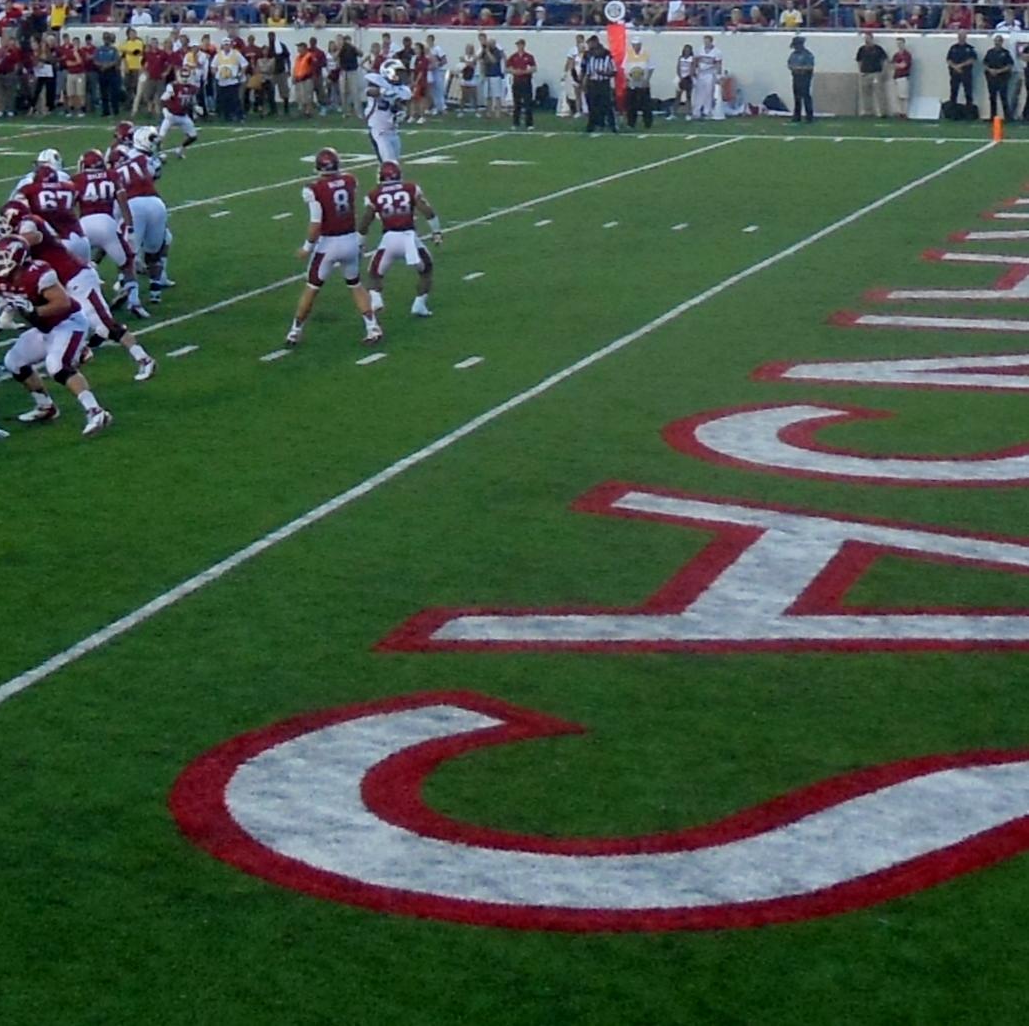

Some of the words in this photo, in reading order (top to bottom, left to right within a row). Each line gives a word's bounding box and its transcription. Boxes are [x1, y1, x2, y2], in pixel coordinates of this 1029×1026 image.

[117, 163, 144, 184] 71
[38, 190, 73, 210] 67
[83, 181, 115, 201] 40
[333, 189, 349, 214] 8
[377, 191, 411, 215] 33
